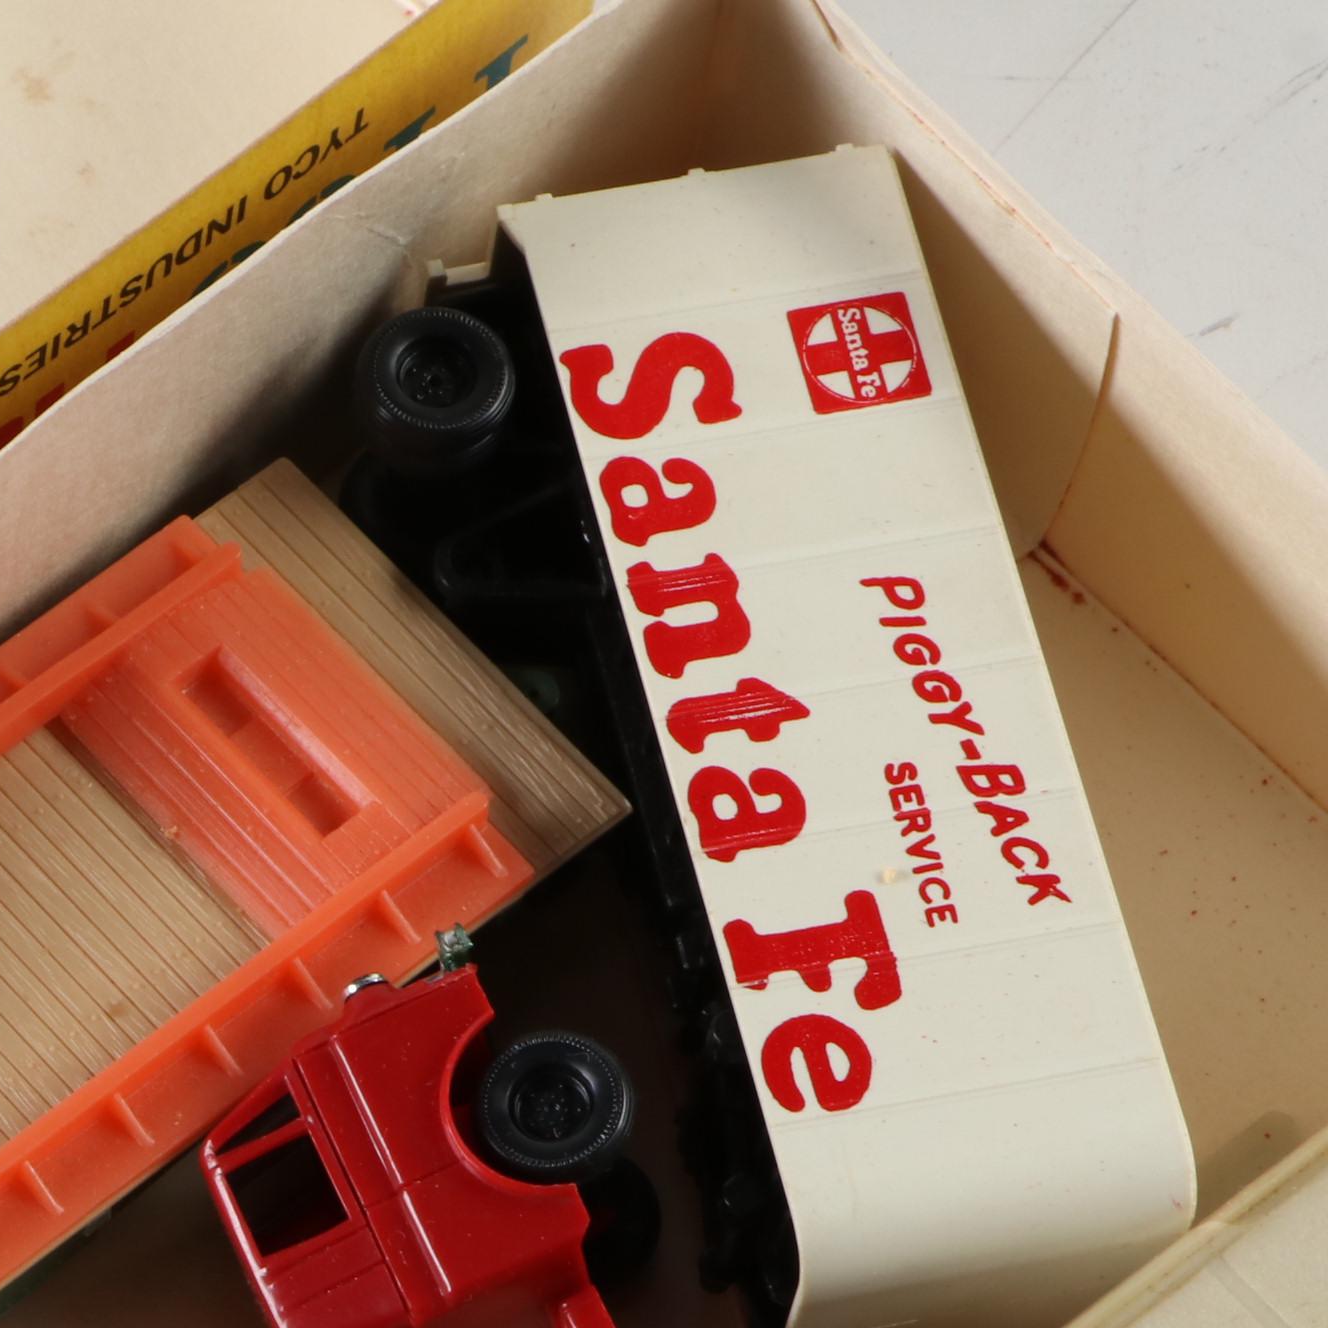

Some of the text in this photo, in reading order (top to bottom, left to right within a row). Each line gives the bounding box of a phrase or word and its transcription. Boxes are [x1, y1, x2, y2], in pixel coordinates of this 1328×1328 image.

[264, 107, 368, 201] TYCO
[837, 307, 881, 398] Santa Fe
[559, 331, 902, 1113] Santa Fe
[859, 576, 1073, 906] PIGGY-BACK
[884, 761, 959, 928] SERVICE
